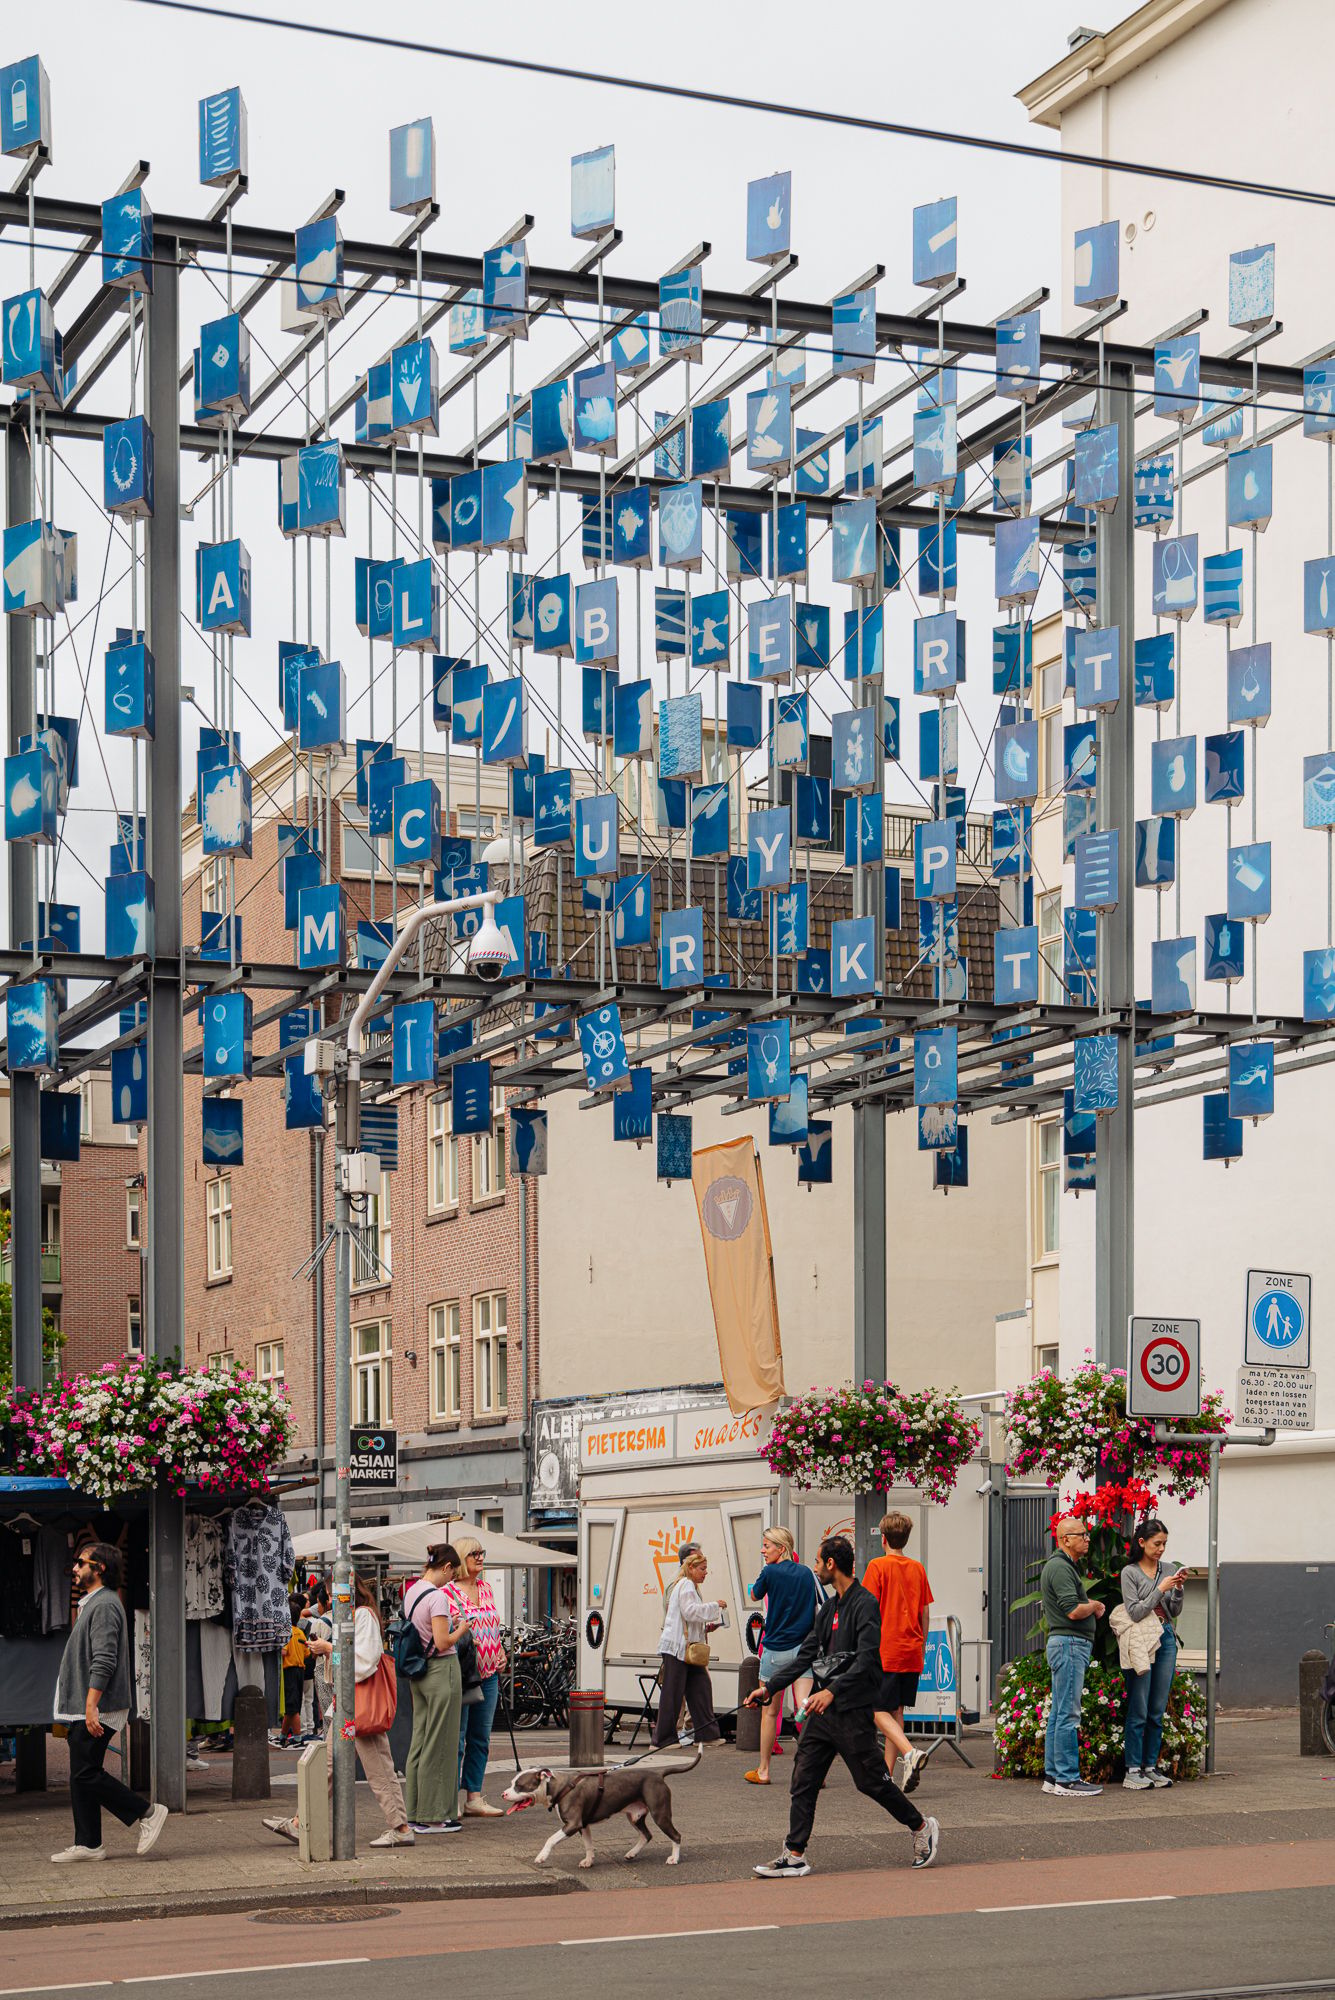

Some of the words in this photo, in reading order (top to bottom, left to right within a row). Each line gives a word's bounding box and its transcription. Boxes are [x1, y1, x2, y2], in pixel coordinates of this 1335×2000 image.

[1265, 1276, 1293, 1288] ZONE
[1151, 1323, 1180, 1334] ZONE
[1150, 1353, 1181, 1376] 30
[1263, 1370, 1277, 1378] t/m
[1240, 1378, 1264, 1386] 06.30
[1273, 1380, 1297, 1389] 20.00
[1246, 1388, 1268, 1397] laden
[1282, 1390, 1307, 1399] lossen
[1246, 1398, 1290, 1407] toegestaan
[1244, 1407, 1269, 1415] 06.30
[1276, 1409, 1296, 1417] 11.00
[1241, 1416, 1264, 1424] 16.30
[1272, 1418, 1294, 1426] 21.00
[587, 1425, 666, 1457] PIETERSMA
[350, 1454, 395, 1468] ASIAN
[350, 1468, 395, 1479] MARKET
